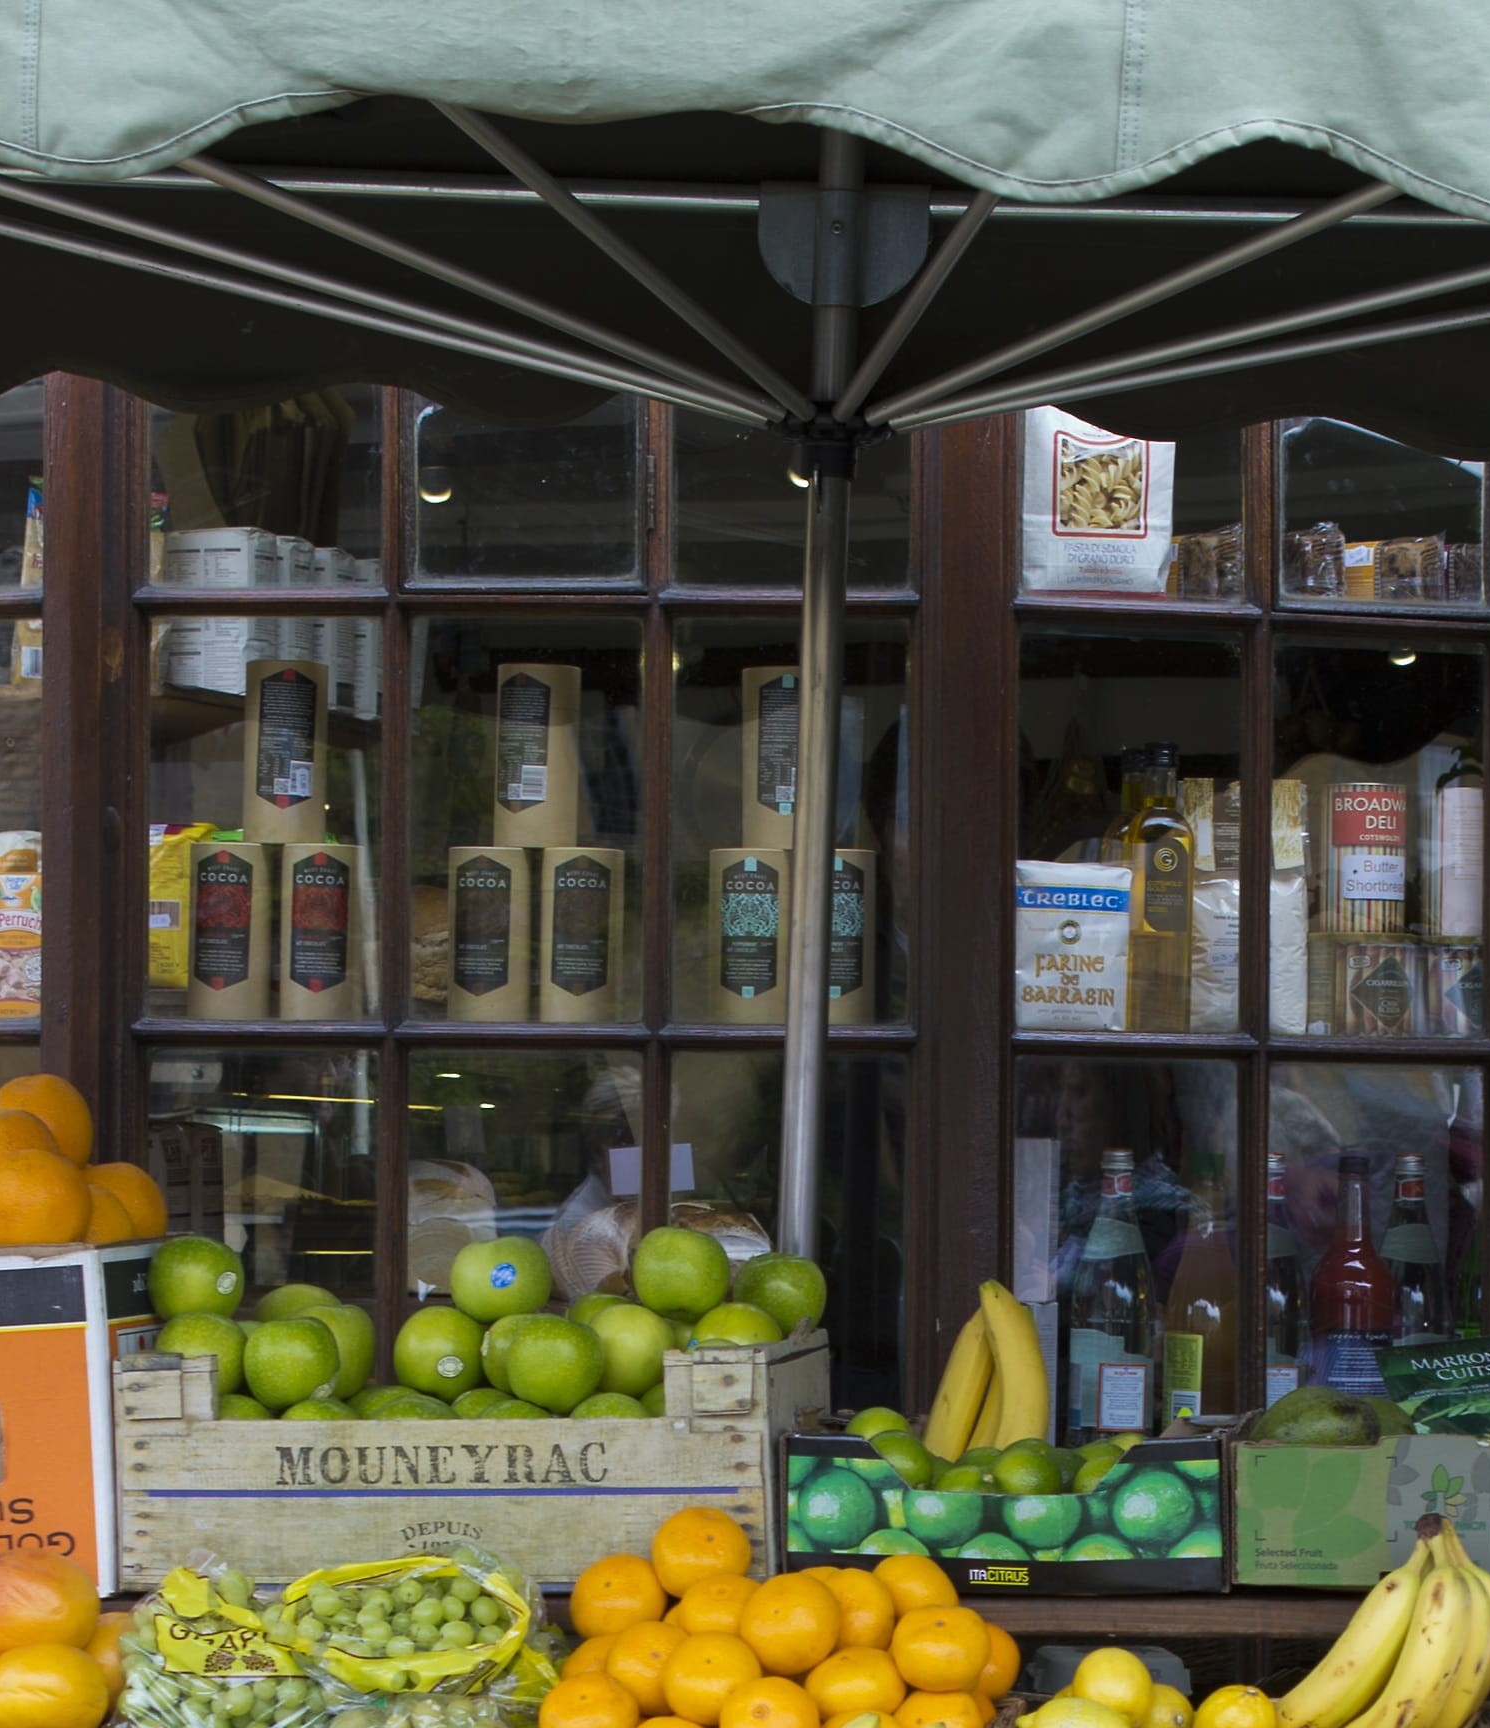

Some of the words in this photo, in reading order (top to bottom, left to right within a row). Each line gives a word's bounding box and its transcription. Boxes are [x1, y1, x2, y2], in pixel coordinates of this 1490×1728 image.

[1365, 816, 1396, 830] DELI
[1363, 861, 1399, 873] Butter
[200, 872, 248, 884] COCOA
[295, 874, 345, 885] COCOA
[458, 878, 507, 888] COCOA
[557, 877, 607, 888] COCOA
[726, 880, 775, 891] COCOA
[275, 1441, 610, 1487] MOUNEYRAC
[399, 1521, 485, 1543] DEPUIS
[1255, 1548, 1297, 1558] Selected
[1299, 1548, 1324, 1558] Fruit
